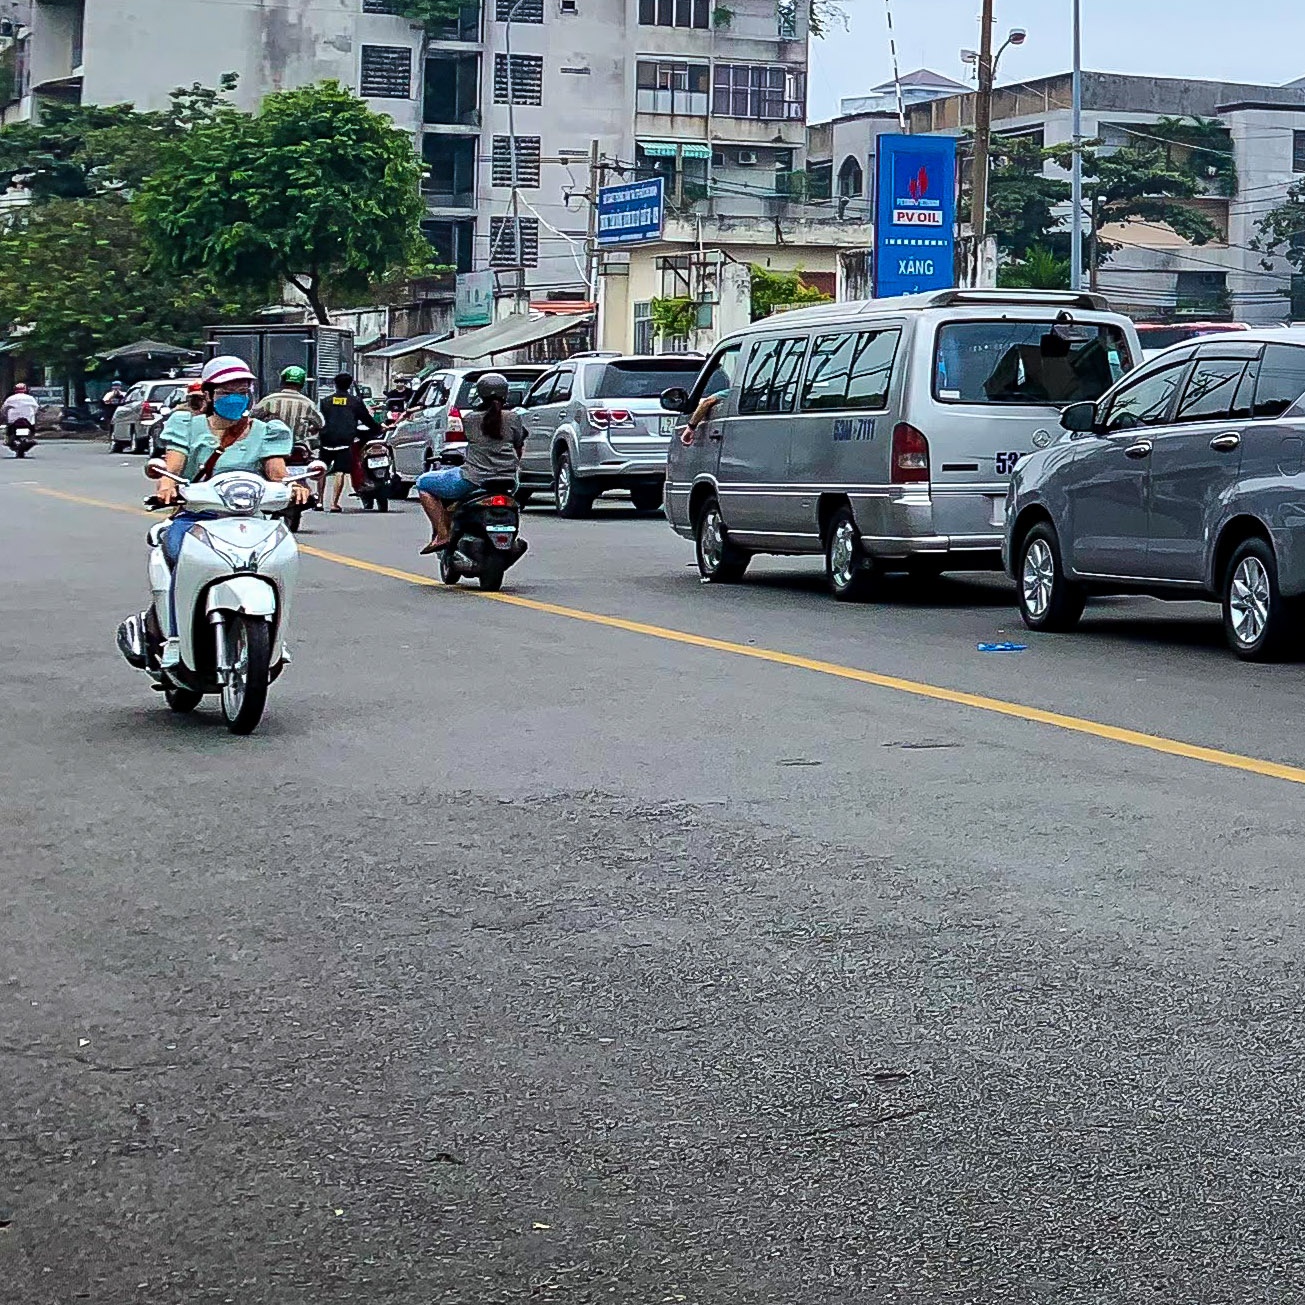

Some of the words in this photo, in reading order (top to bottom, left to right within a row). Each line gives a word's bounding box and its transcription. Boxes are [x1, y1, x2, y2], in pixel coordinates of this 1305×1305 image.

[896, 211, 914, 223] PV
[917, 212, 940, 223] OIL
[898, 255, 934, 276] XĂNG
[995, 451, 1027, 475] 53
